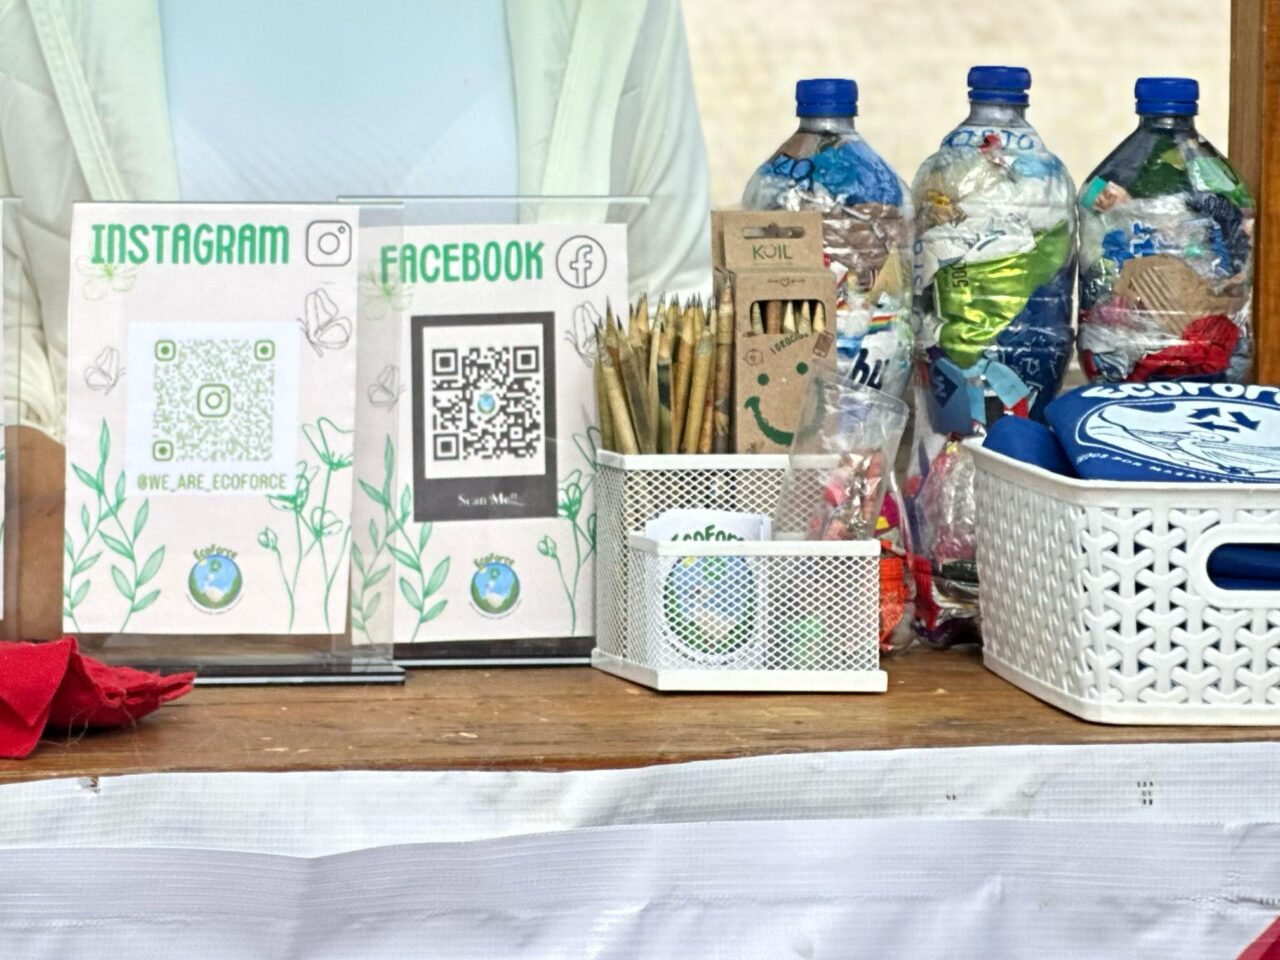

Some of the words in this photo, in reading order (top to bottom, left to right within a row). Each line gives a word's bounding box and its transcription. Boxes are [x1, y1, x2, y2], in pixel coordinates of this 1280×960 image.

[91, 223, 289, 265] INSTAGRAM
[380, 240, 544, 283] FACEBOOK
[136, 473, 287, 492] @WE_ARE_ECOFORCE
